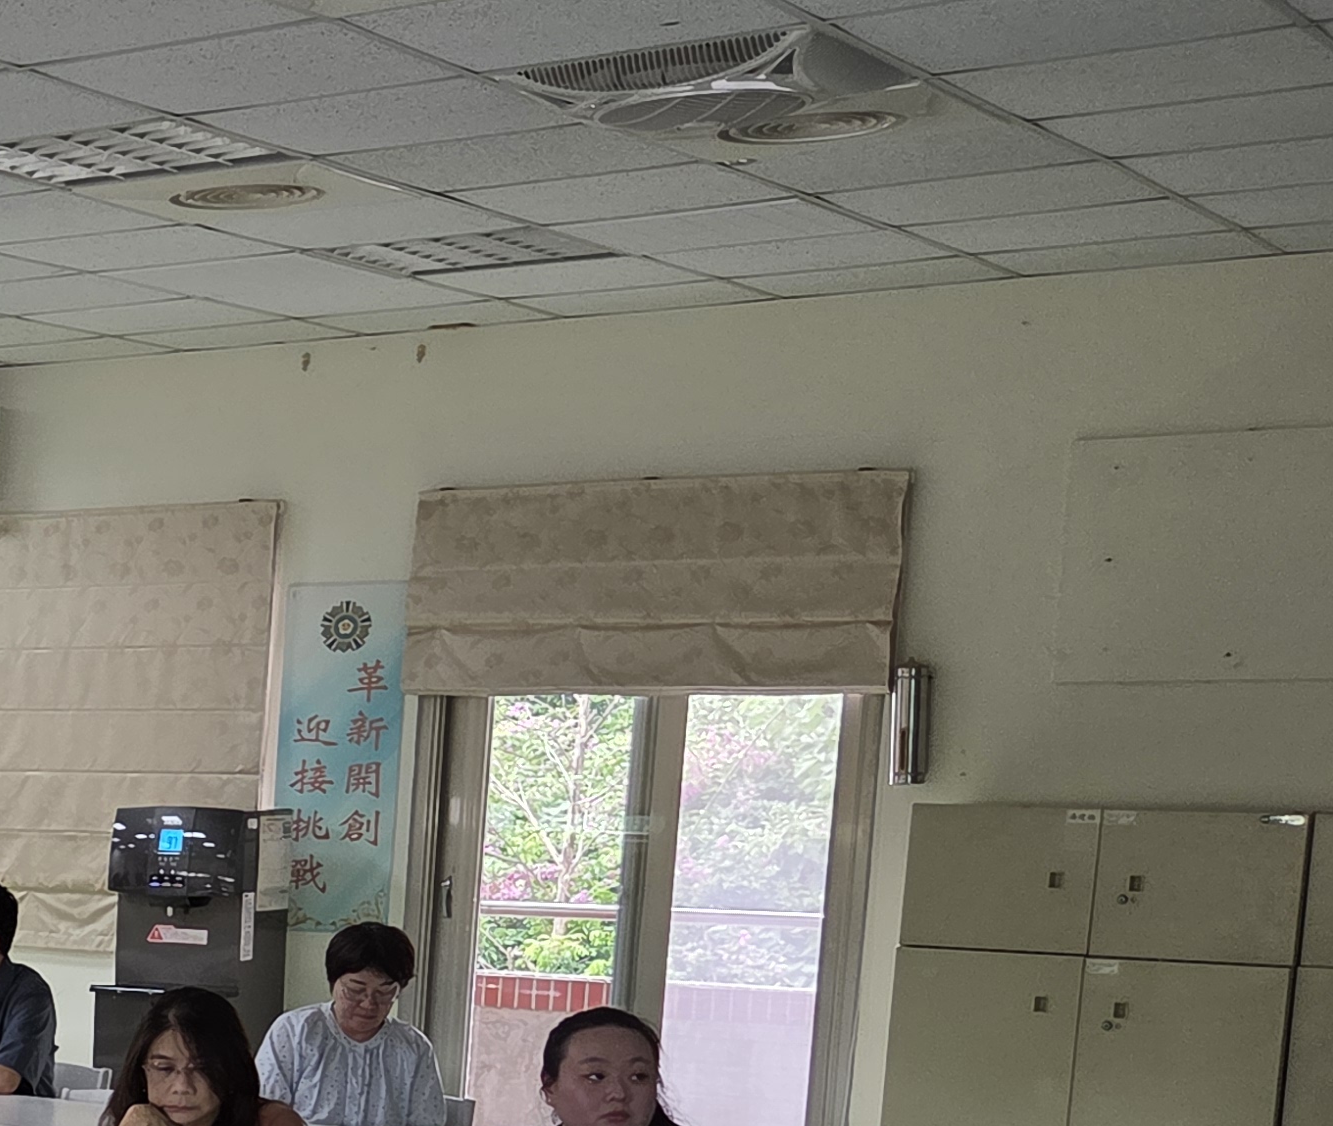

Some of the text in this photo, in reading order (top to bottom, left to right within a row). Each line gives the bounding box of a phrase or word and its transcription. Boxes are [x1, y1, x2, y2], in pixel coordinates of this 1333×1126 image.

[289, 714, 338, 893] 迎接挑戰
[339, 659, 389, 846] 革新開創
